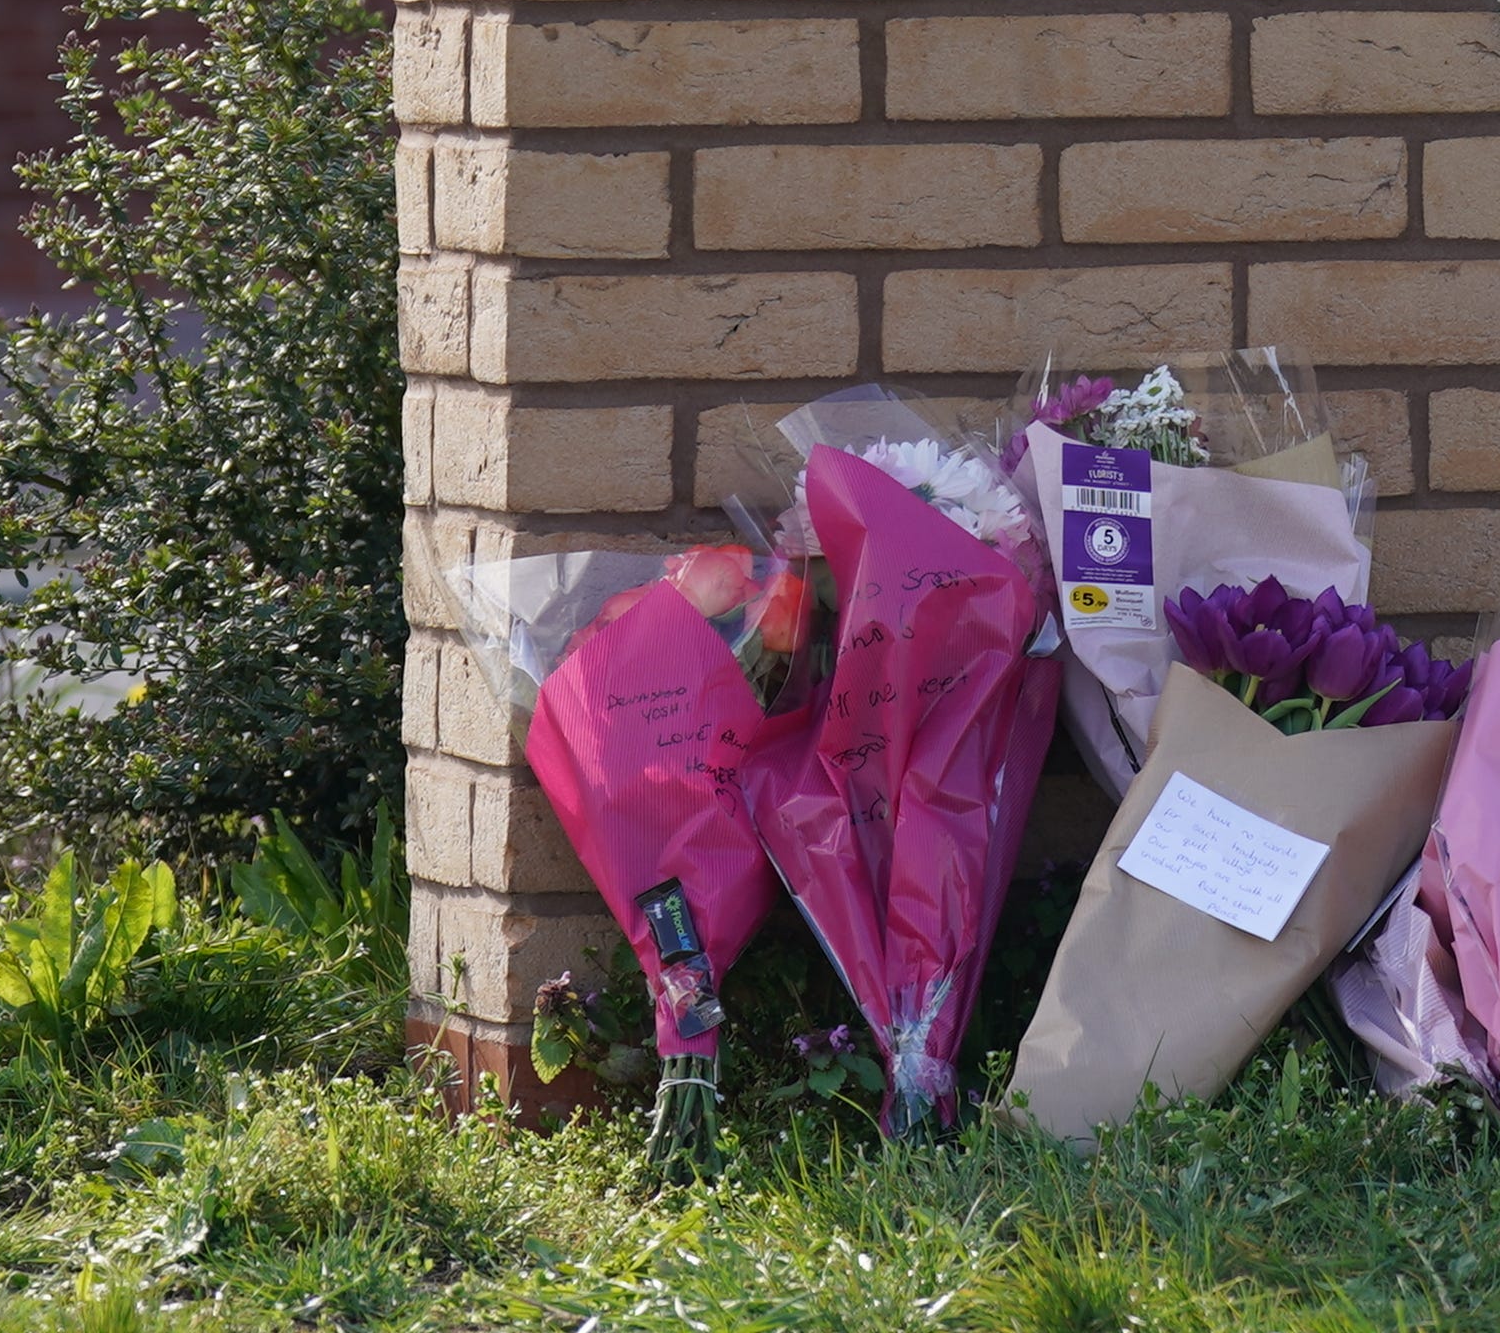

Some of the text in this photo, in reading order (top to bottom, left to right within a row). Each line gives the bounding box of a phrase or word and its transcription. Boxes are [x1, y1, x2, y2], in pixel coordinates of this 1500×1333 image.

[1104, 529, 1113, 545] 5
[1097, 545, 1117, 553] DAYS
[1177, 789, 1197, 807] We
